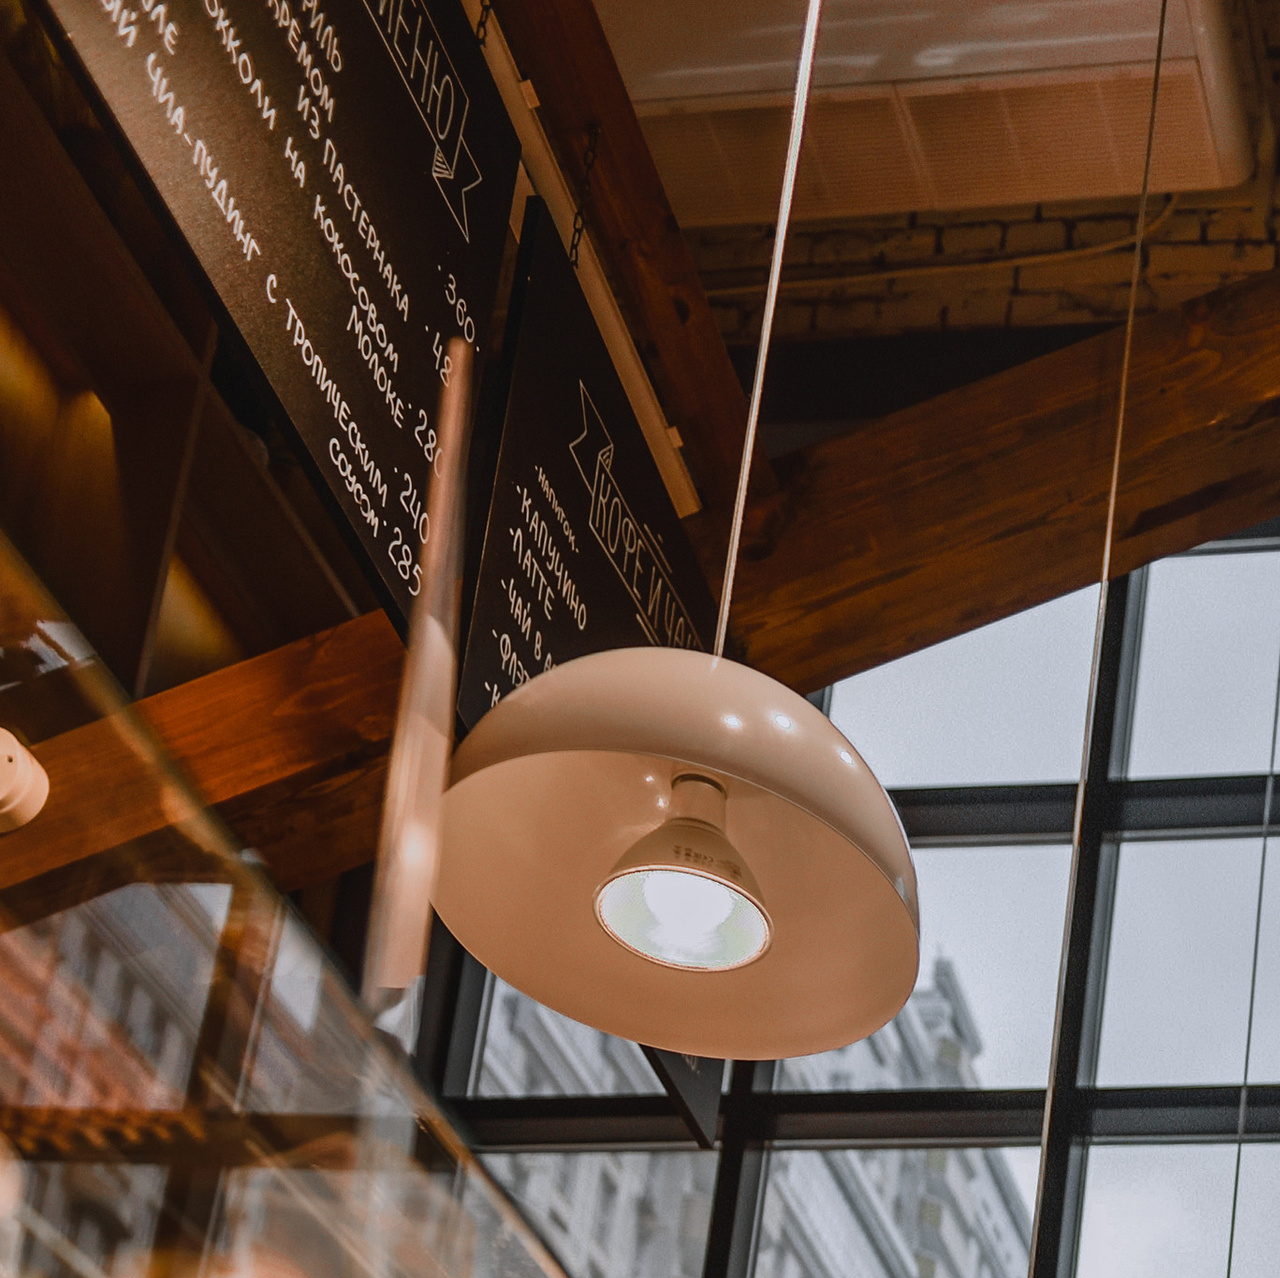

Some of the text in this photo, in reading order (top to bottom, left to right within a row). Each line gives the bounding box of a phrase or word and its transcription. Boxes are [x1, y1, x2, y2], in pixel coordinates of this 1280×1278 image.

[284, 136, 306, 188] НА
[313, 194, 399, 373] КОКОСОВОМ
[298, 85, 320, 139] ИЗ
[323, 138, 409, 322] ПАСТЕРНАКА
[147, 52, 261, 261] ЧИА-ПУДИНГ
[266, 273, 277, 303] С
[285, 298, 388, 507] ТРОПИЧЕСКИМ
[445, 273, 475, 343] 360
[346, 305, 404, 428] МОЛОКЕ
[328, 437, 423, 596] СОУСОМ 285
[399, 472, 430, 544] 240
[521, 487, 587, 630] КАПУЧИНО
[537, 467, 576, 551] НАПИТОК
[596, 473, 646, 600] КОФЕ
[508, 578, 531, 641] ЧАЙ
[534, 630, 542, 661] В
[512, 527, 555, 620] ЛАТТЕ
